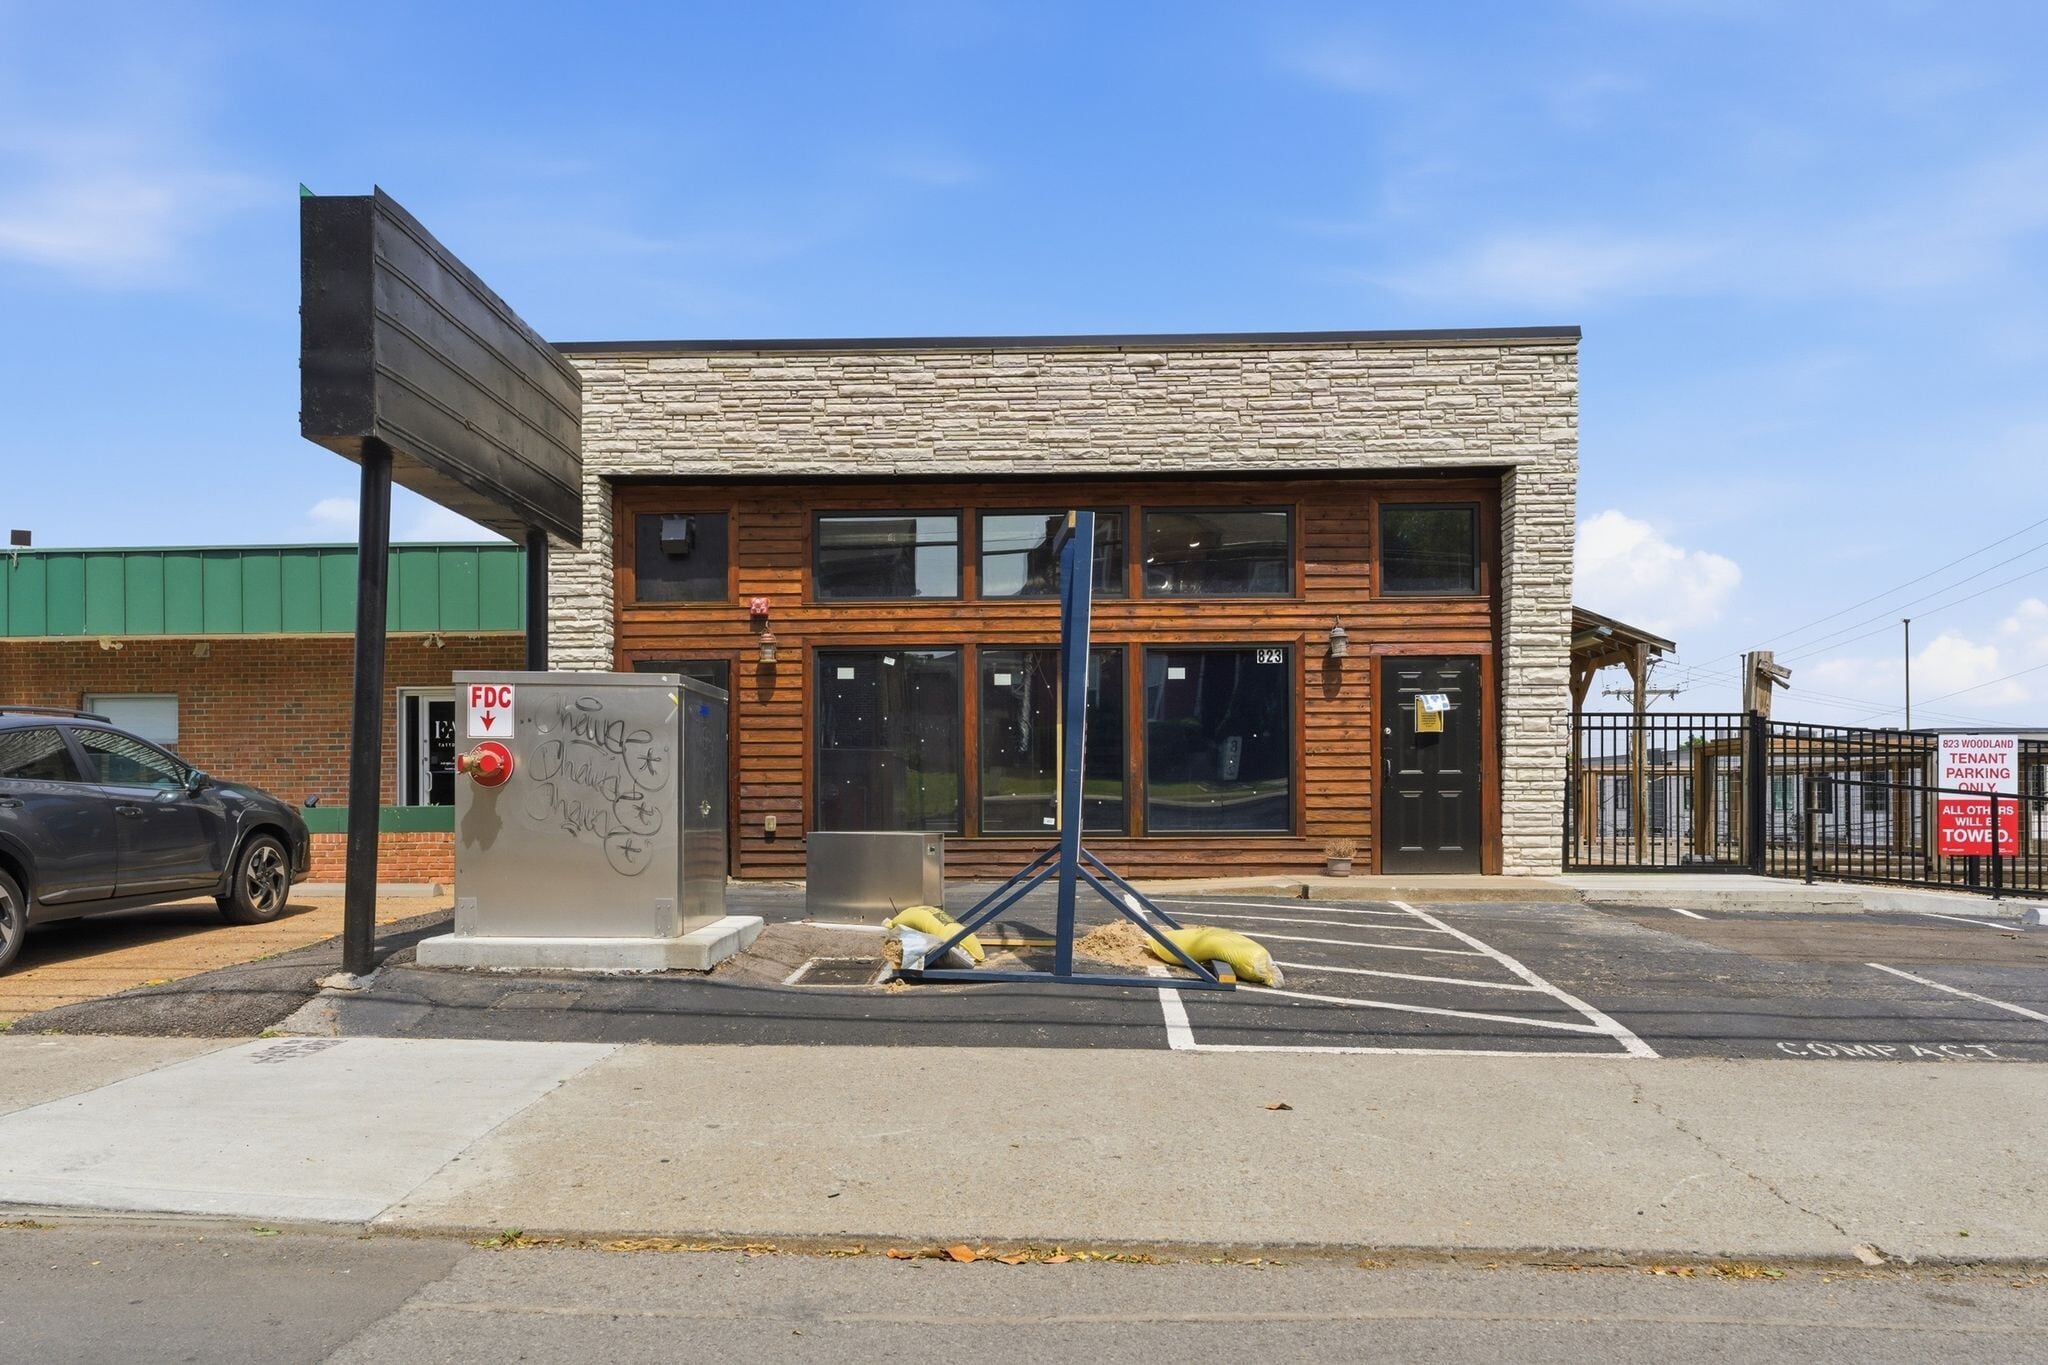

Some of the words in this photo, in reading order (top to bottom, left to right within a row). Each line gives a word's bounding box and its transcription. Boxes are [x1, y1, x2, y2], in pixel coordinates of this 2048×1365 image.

[1258, 650, 1281, 663] 823
[471, 686, 511, 708] FDC
[1942, 739, 1959, 749] 823
[1961, 739, 2014, 749] WOODLAND
[1950, 753, 2007, 764] TENANT
[1946, 767, 2011, 779] PARKING
[1942, 805, 1964, 815] ALL
[1966, 805, 2014, 815] OTHRS
[1955, 817, 1983, 826] WILL
